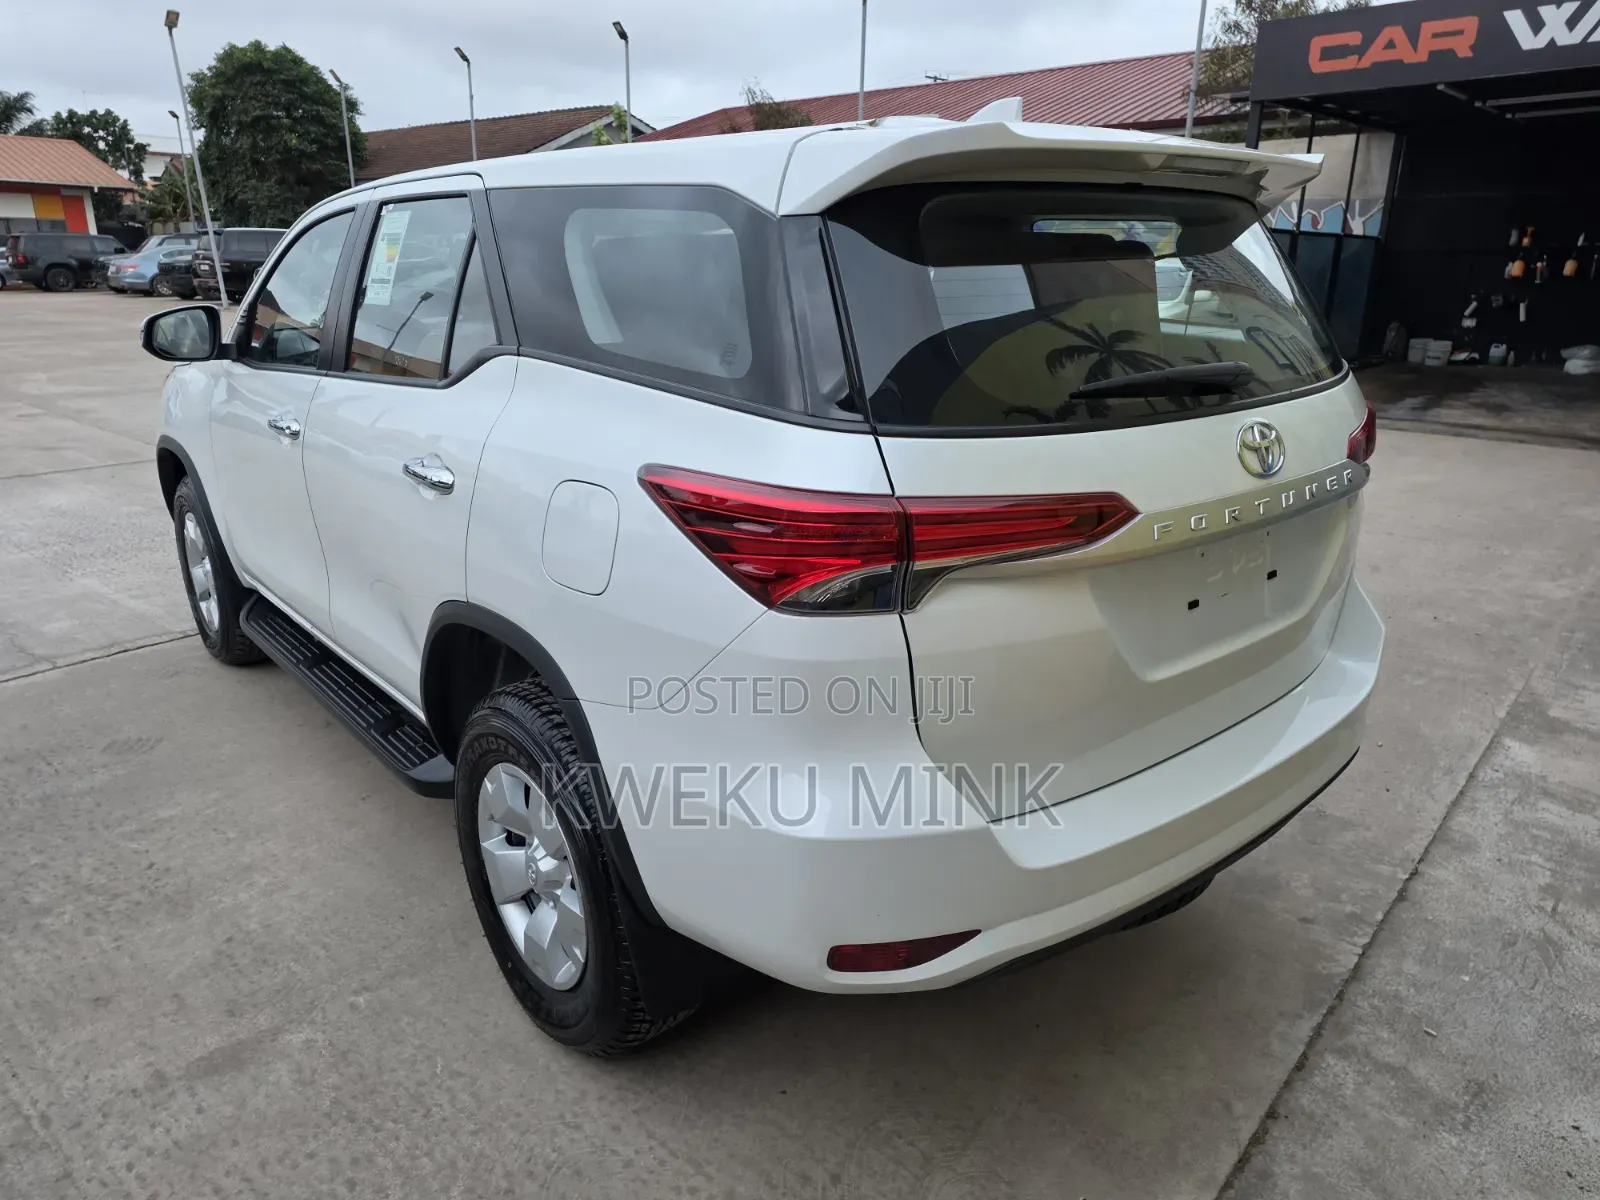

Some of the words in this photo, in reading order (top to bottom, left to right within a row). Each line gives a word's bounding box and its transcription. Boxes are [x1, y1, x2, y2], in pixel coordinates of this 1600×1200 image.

[1308, 16, 1479, 74] CAR
[1503, 0, 1600, 51] W
[1153, 468, 1353, 541] FORTUNER
